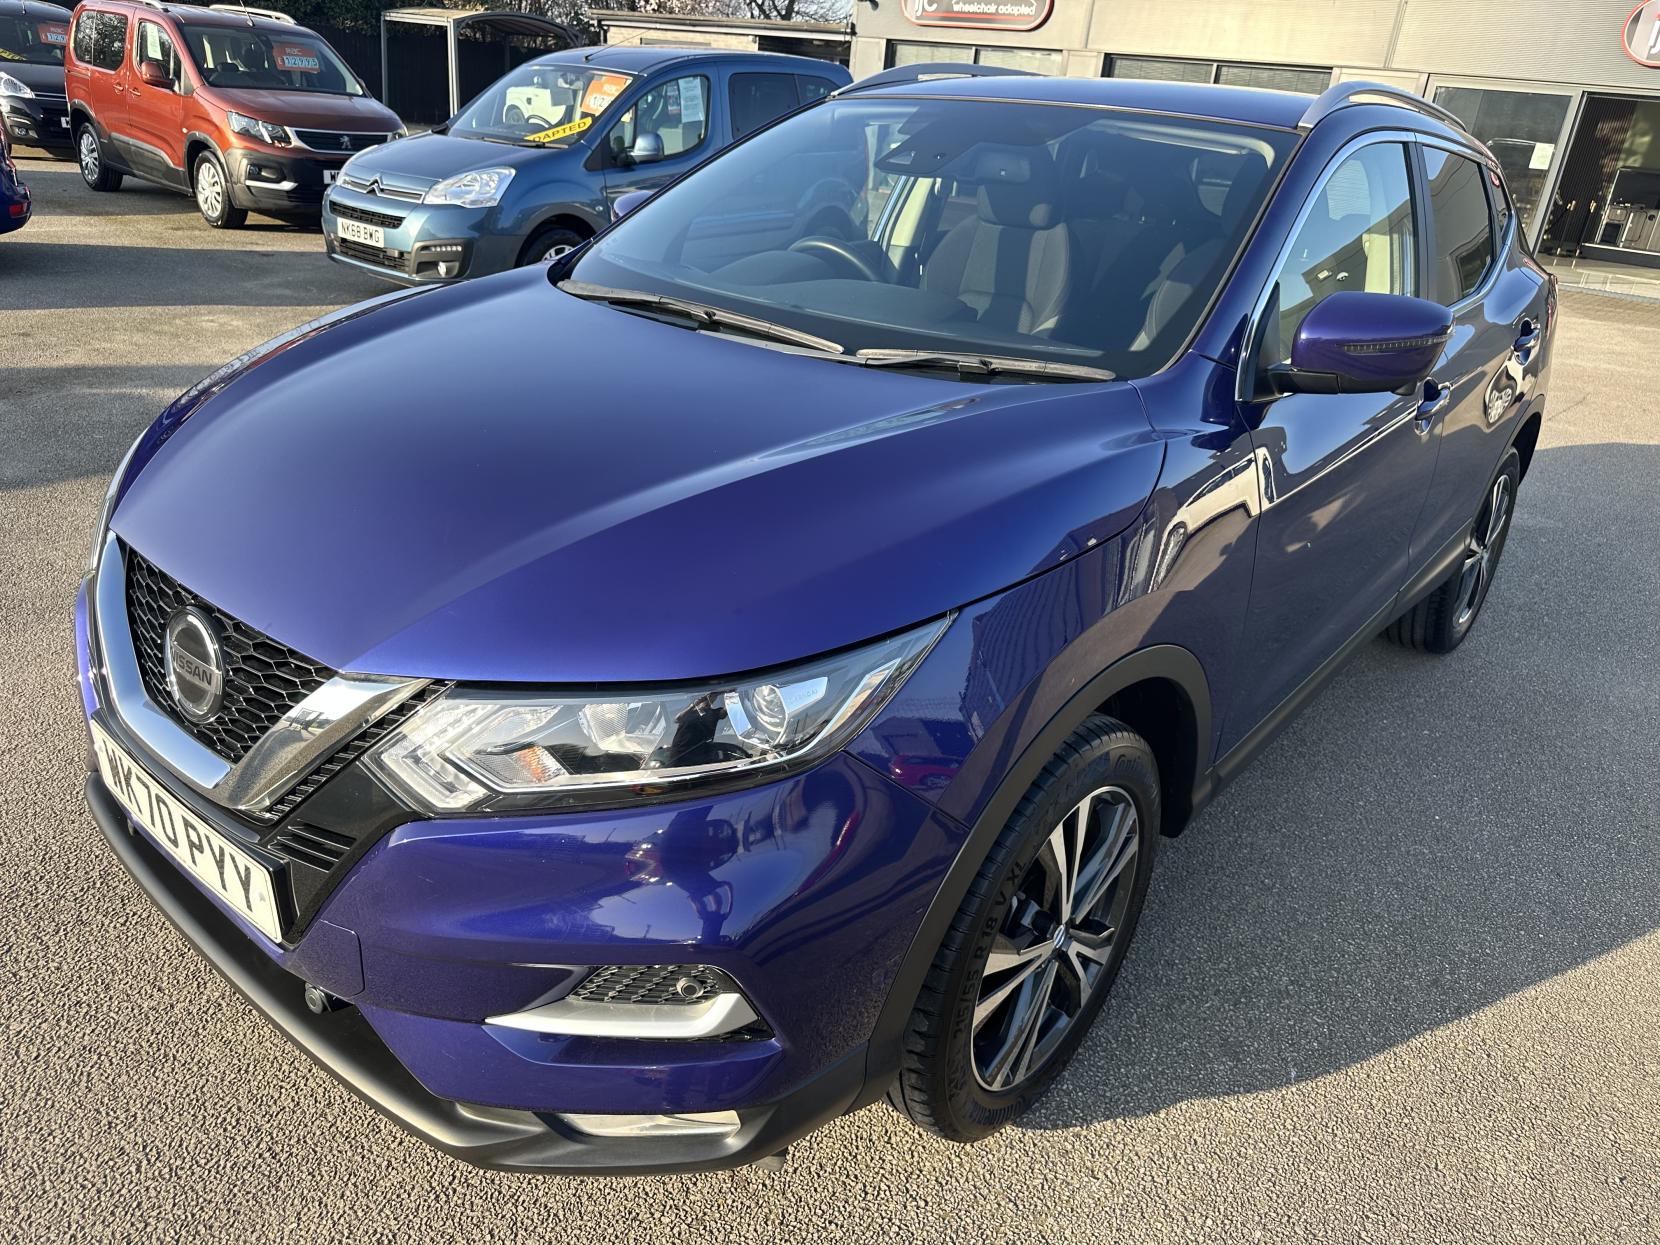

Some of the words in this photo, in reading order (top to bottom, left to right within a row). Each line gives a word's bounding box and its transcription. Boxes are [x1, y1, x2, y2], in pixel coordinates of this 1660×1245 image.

[953, 2, 998, 13] wheelchair
[998, 4, 1036, 16] adapted
[363, 226, 380, 243] BWG
[102, 738, 180, 849] WK70
[181, 814, 254, 913] PYY
[982, 916, 998, 938] 18
[1007, 861, 1027, 887] XL
